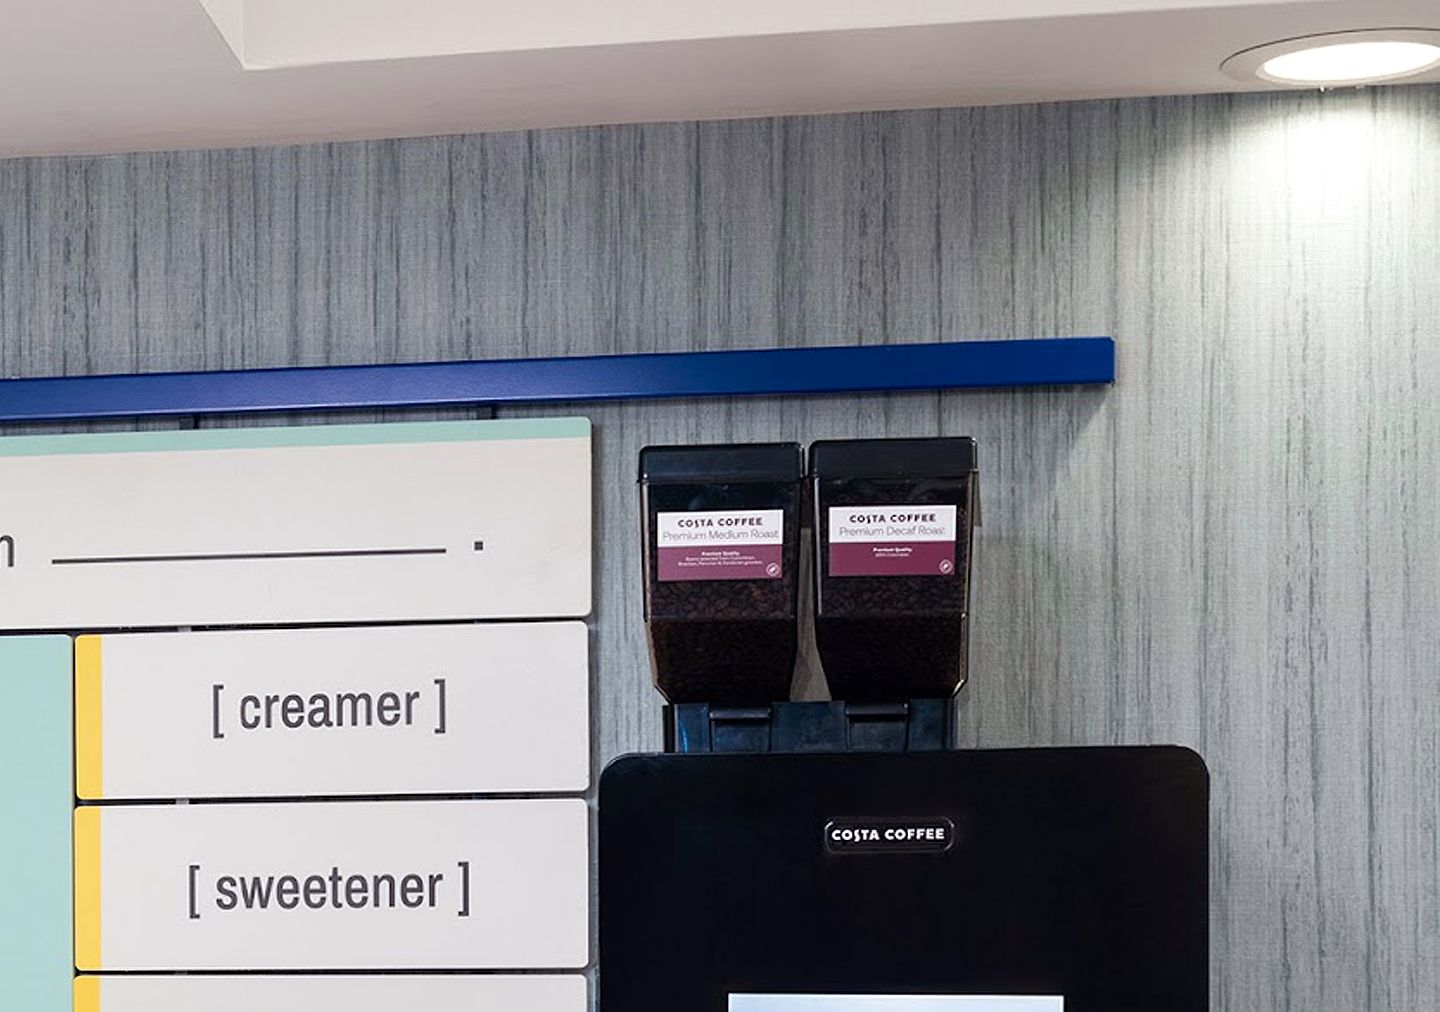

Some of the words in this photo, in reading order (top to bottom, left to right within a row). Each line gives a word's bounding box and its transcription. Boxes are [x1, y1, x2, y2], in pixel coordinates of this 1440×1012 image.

[677, 519, 714, 528] COSTA
[717, 517, 763, 526] COFFEE
[849, 514, 886, 524] COSTA
[890, 513, 936, 523] COFFEE
[662, 530, 706, 541] Premium
[708, 529, 749, 540] Medium
[750, 528, 780, 538] Roast
[839, 526, 885, 537] Premium
[886, 525, 917, 536] Decaf
[831, 828, 880, 842] COSTA
[884, 828, 945, 840] COFFEE
